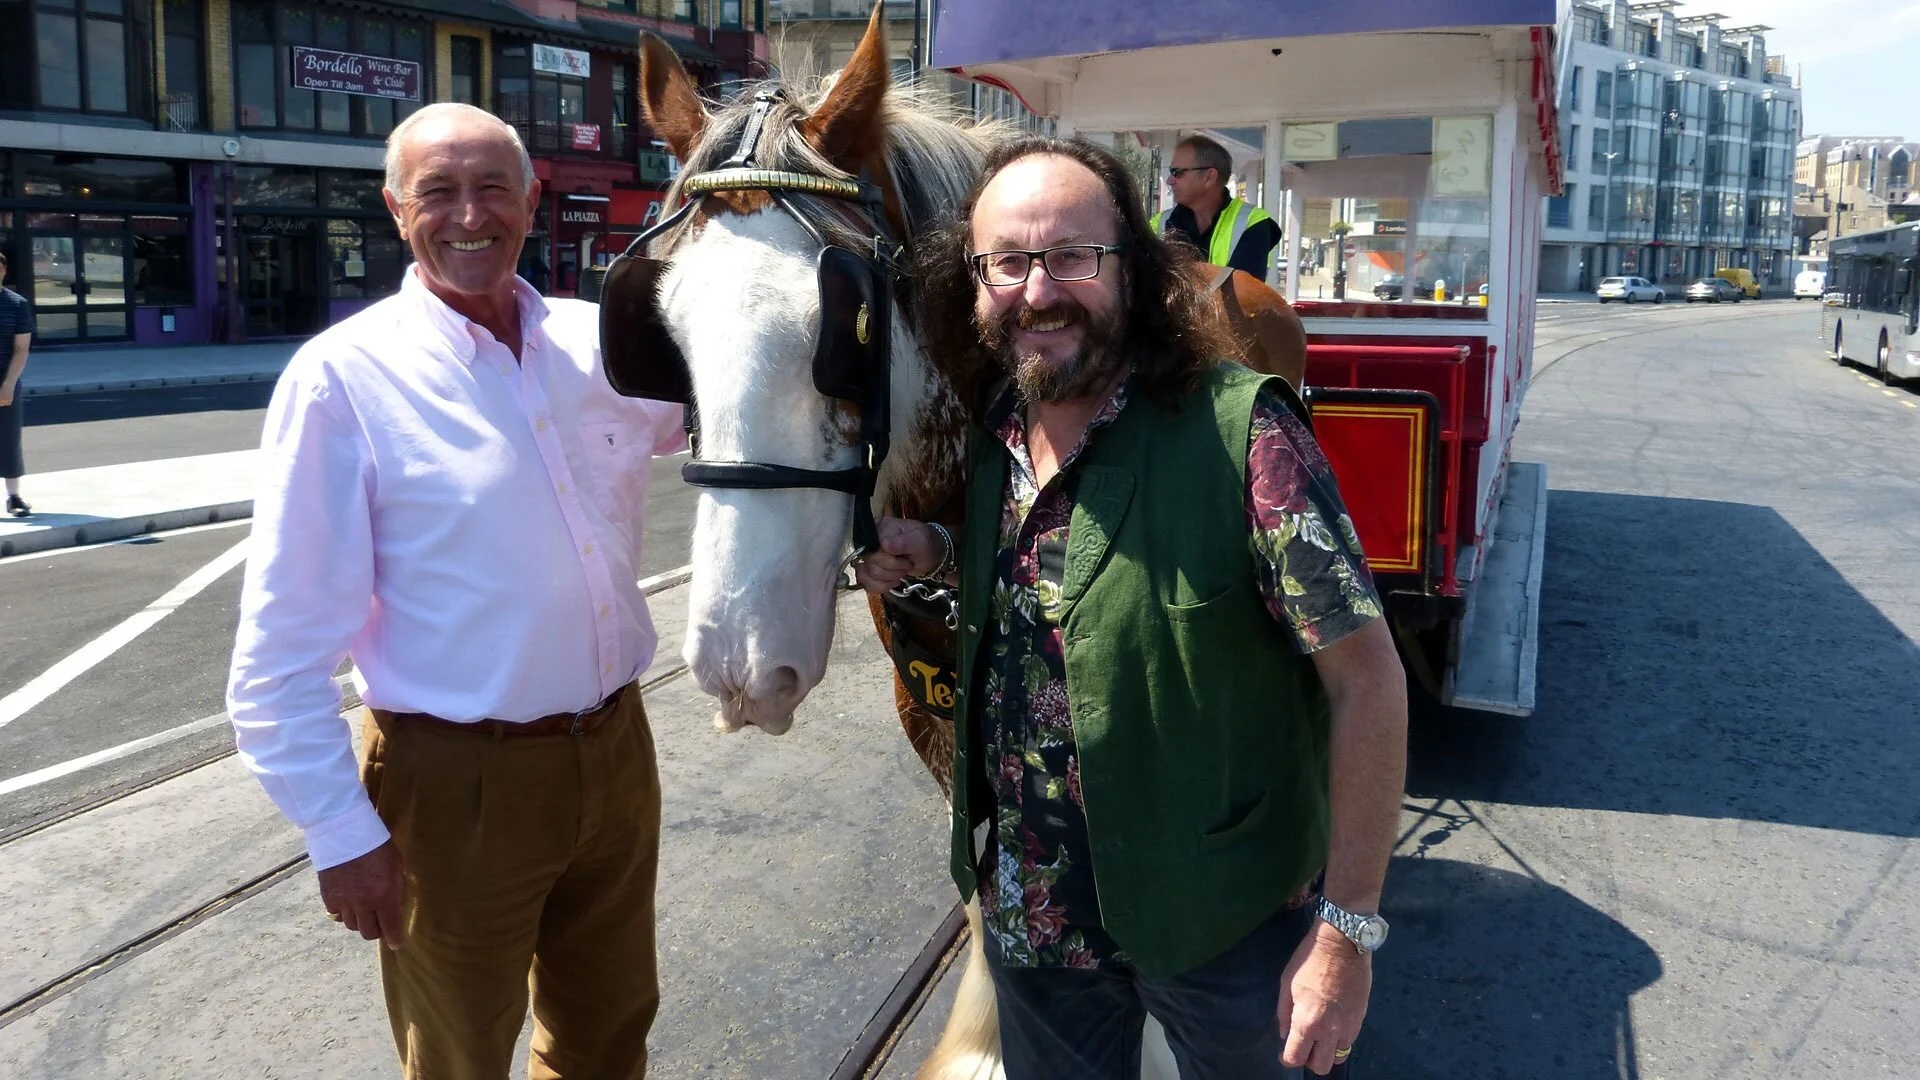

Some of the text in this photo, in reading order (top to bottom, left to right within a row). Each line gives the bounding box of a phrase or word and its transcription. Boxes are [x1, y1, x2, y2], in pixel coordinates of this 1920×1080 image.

[304, 55, 362, 77] Bordello
[367, 60, 412, 75] Wine Bar
[536, 52, 588, 70] LA PIAZZA
[304, 77, 363, 91] Open Till 3am
[373, 76, 405, 87] & Club
[563, 211, 599, 222] LA PIAZZA
[909, 660, 956, 708] Te
